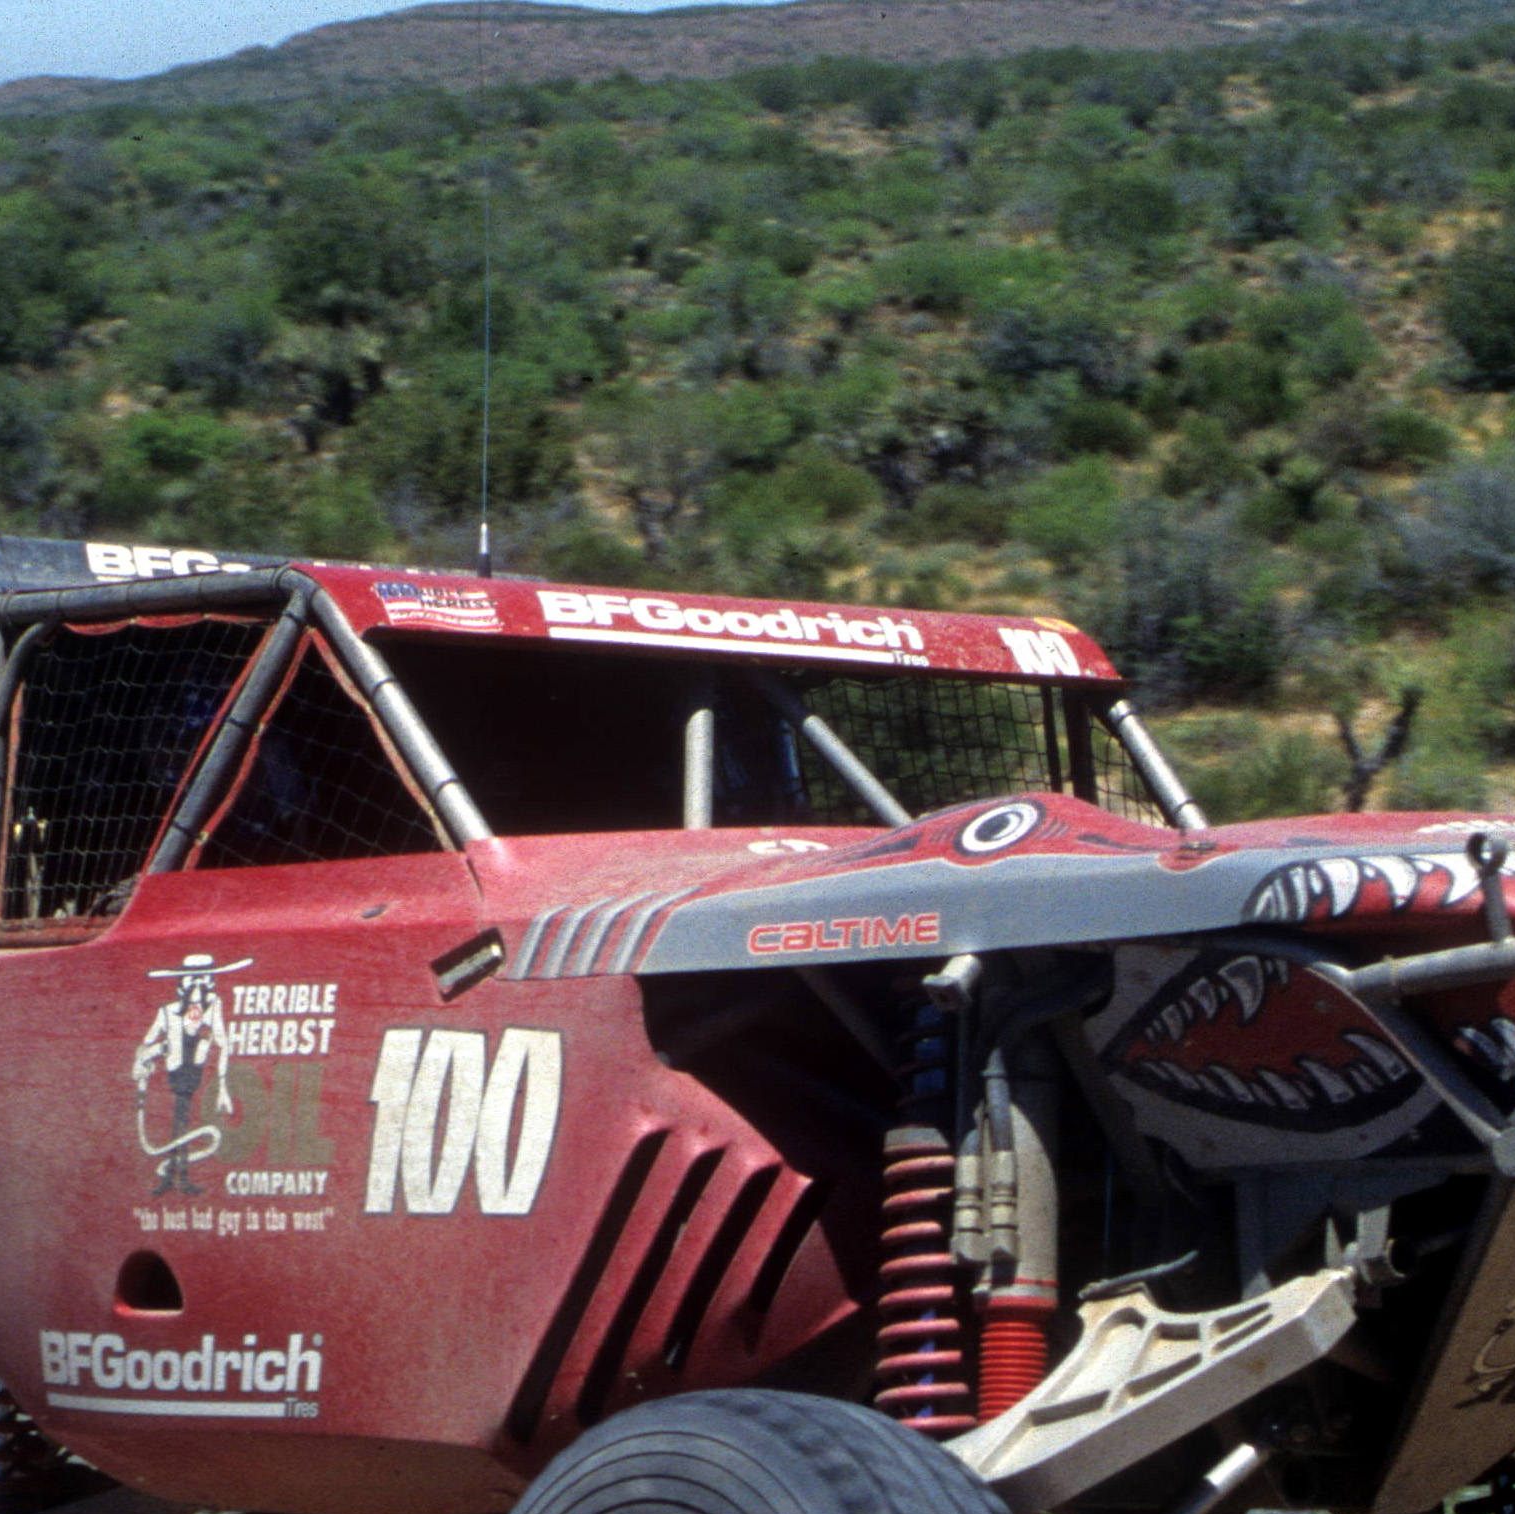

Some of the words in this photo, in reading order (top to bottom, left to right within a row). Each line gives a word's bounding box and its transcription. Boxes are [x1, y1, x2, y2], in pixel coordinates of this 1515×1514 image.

[536, 590, 924, 649] BFGoodrich
[997, 627, 1081, 676] 100
[233, 984, 338, 1015] TERRIBLE
[228, 1019, 335, 1055] HERBST
[200, 1062, 334, 1165] OIL
[364, 1027, 563, 1214] 100
[225, 1171, 328, 1195] COMPANY
[218, 1208, 241, 1236] guy
[246, 1206, 260, 1231] in
[265, 1206, 287, 1231] the
[39, 1330, 323, 1392] BFGoodrich
